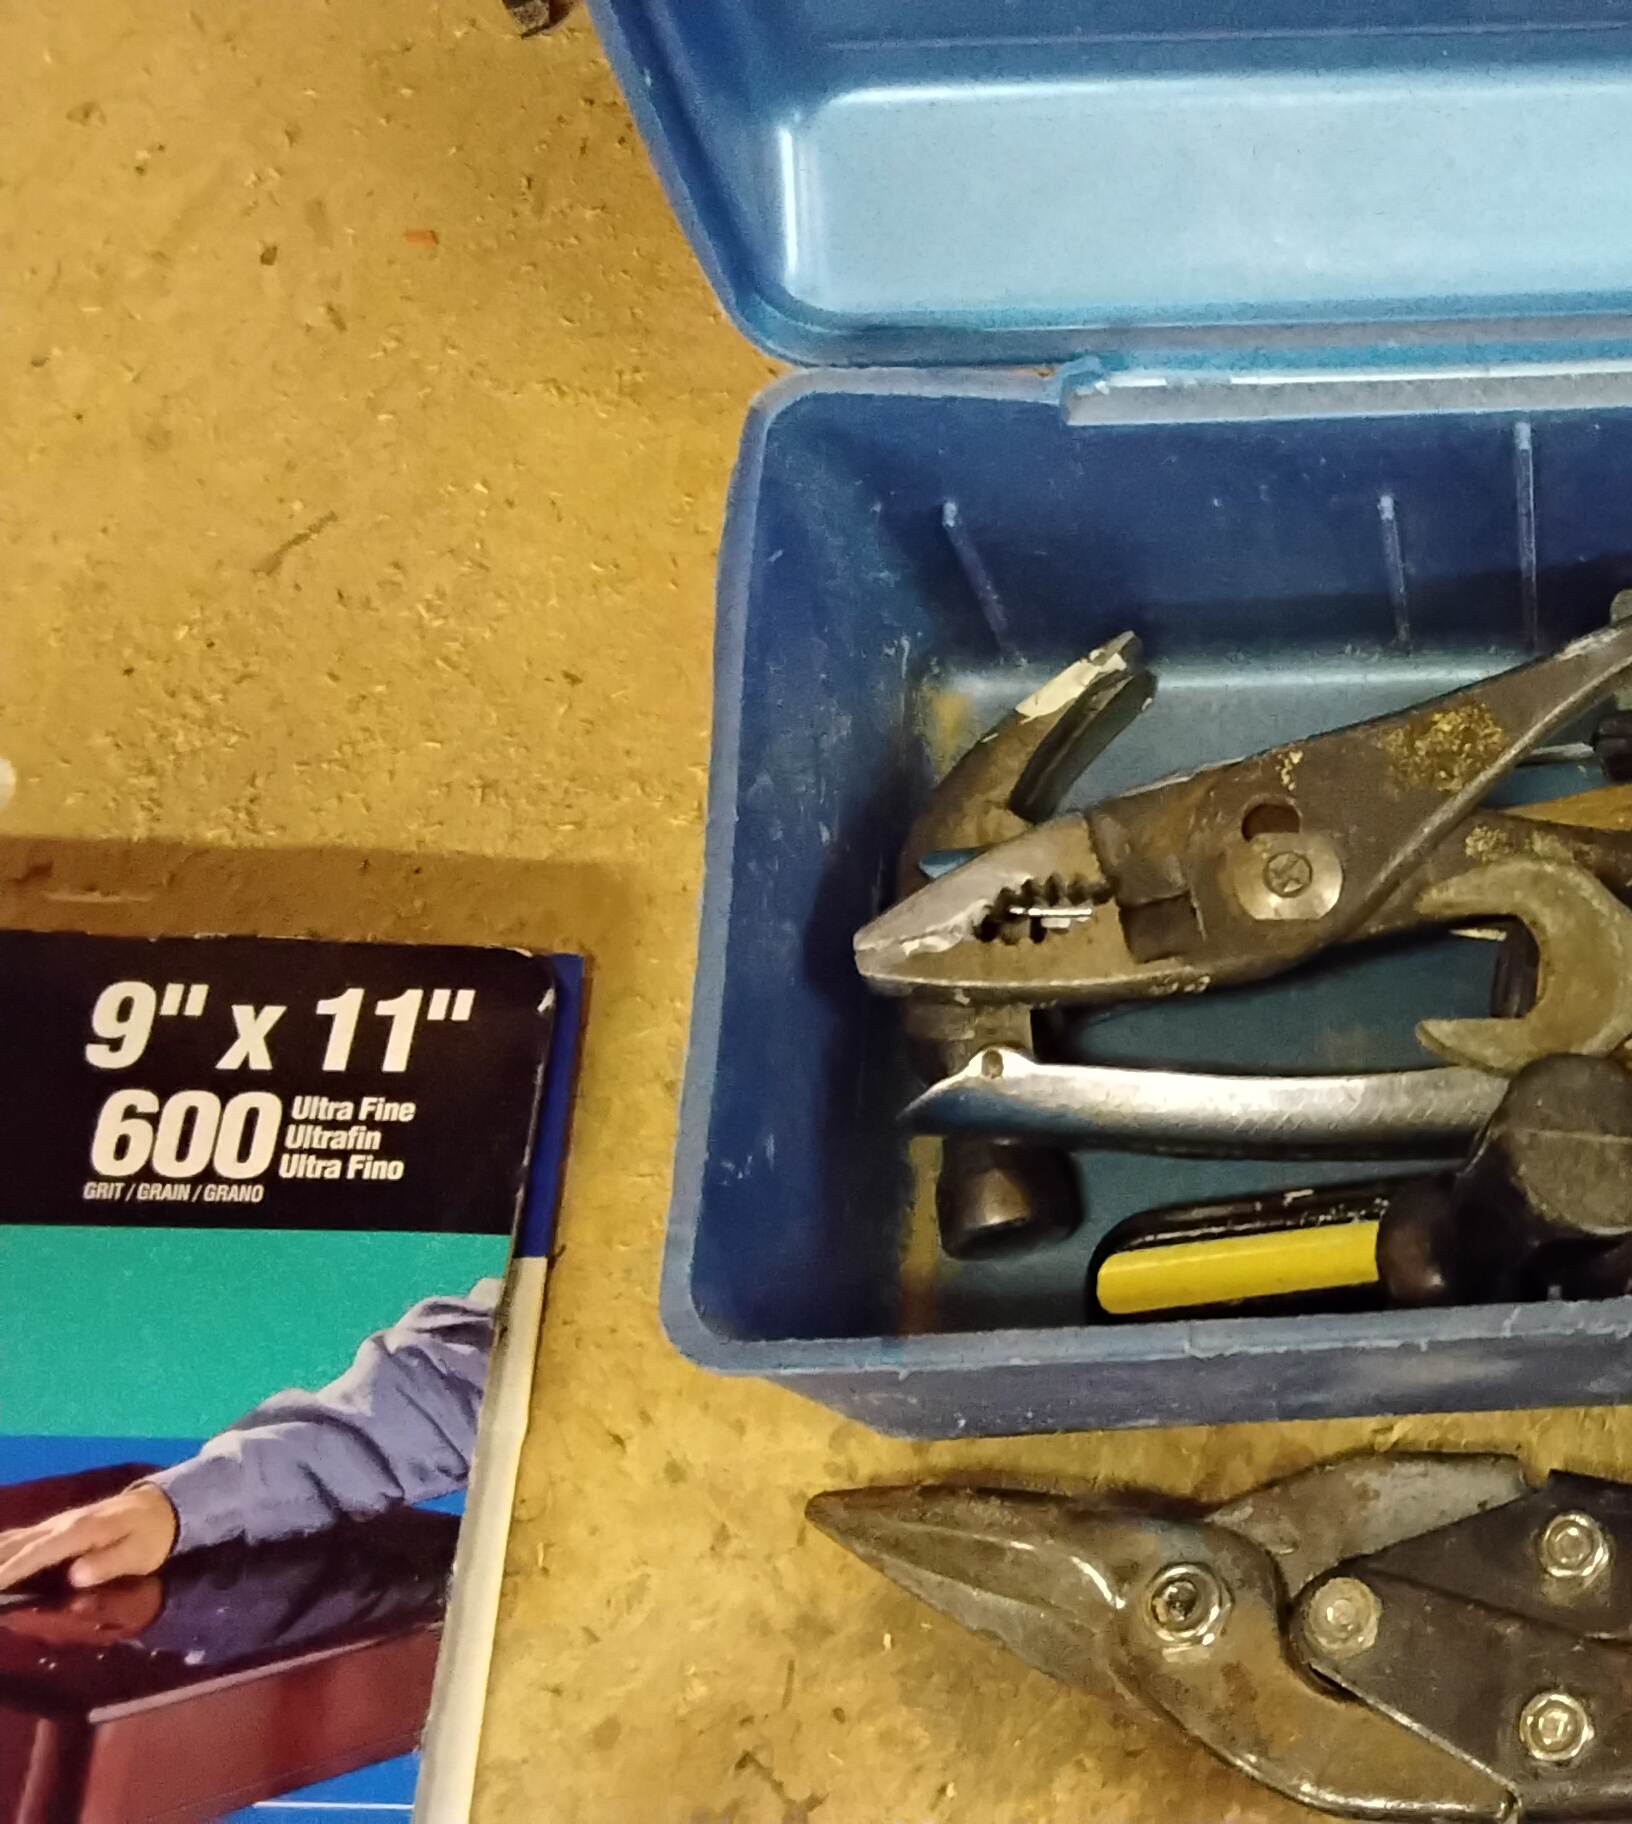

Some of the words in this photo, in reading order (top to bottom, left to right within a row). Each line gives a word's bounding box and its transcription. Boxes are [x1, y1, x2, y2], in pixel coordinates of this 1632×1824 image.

[85, 980, 209, 1070] 9"
[215, 1004, 288, 1071] x
[315, 987, 476, 1073] 11"
[291, 1095, 355, 1121] Ultra
[357, 1096, 417, 1123] Fine
[90, 1088, 283, 1180] 600
[284, 1123, 382, 1151] Ultrafin
[278, 1153, 343, 1180] Ultra
[346, 1154, 405, 1181] Fino
[83, 1181, 126, 1200] GRIT
[136, 1182, 192, 1201] GRAIN
[203, 1184, 265, 1203] GRANO
